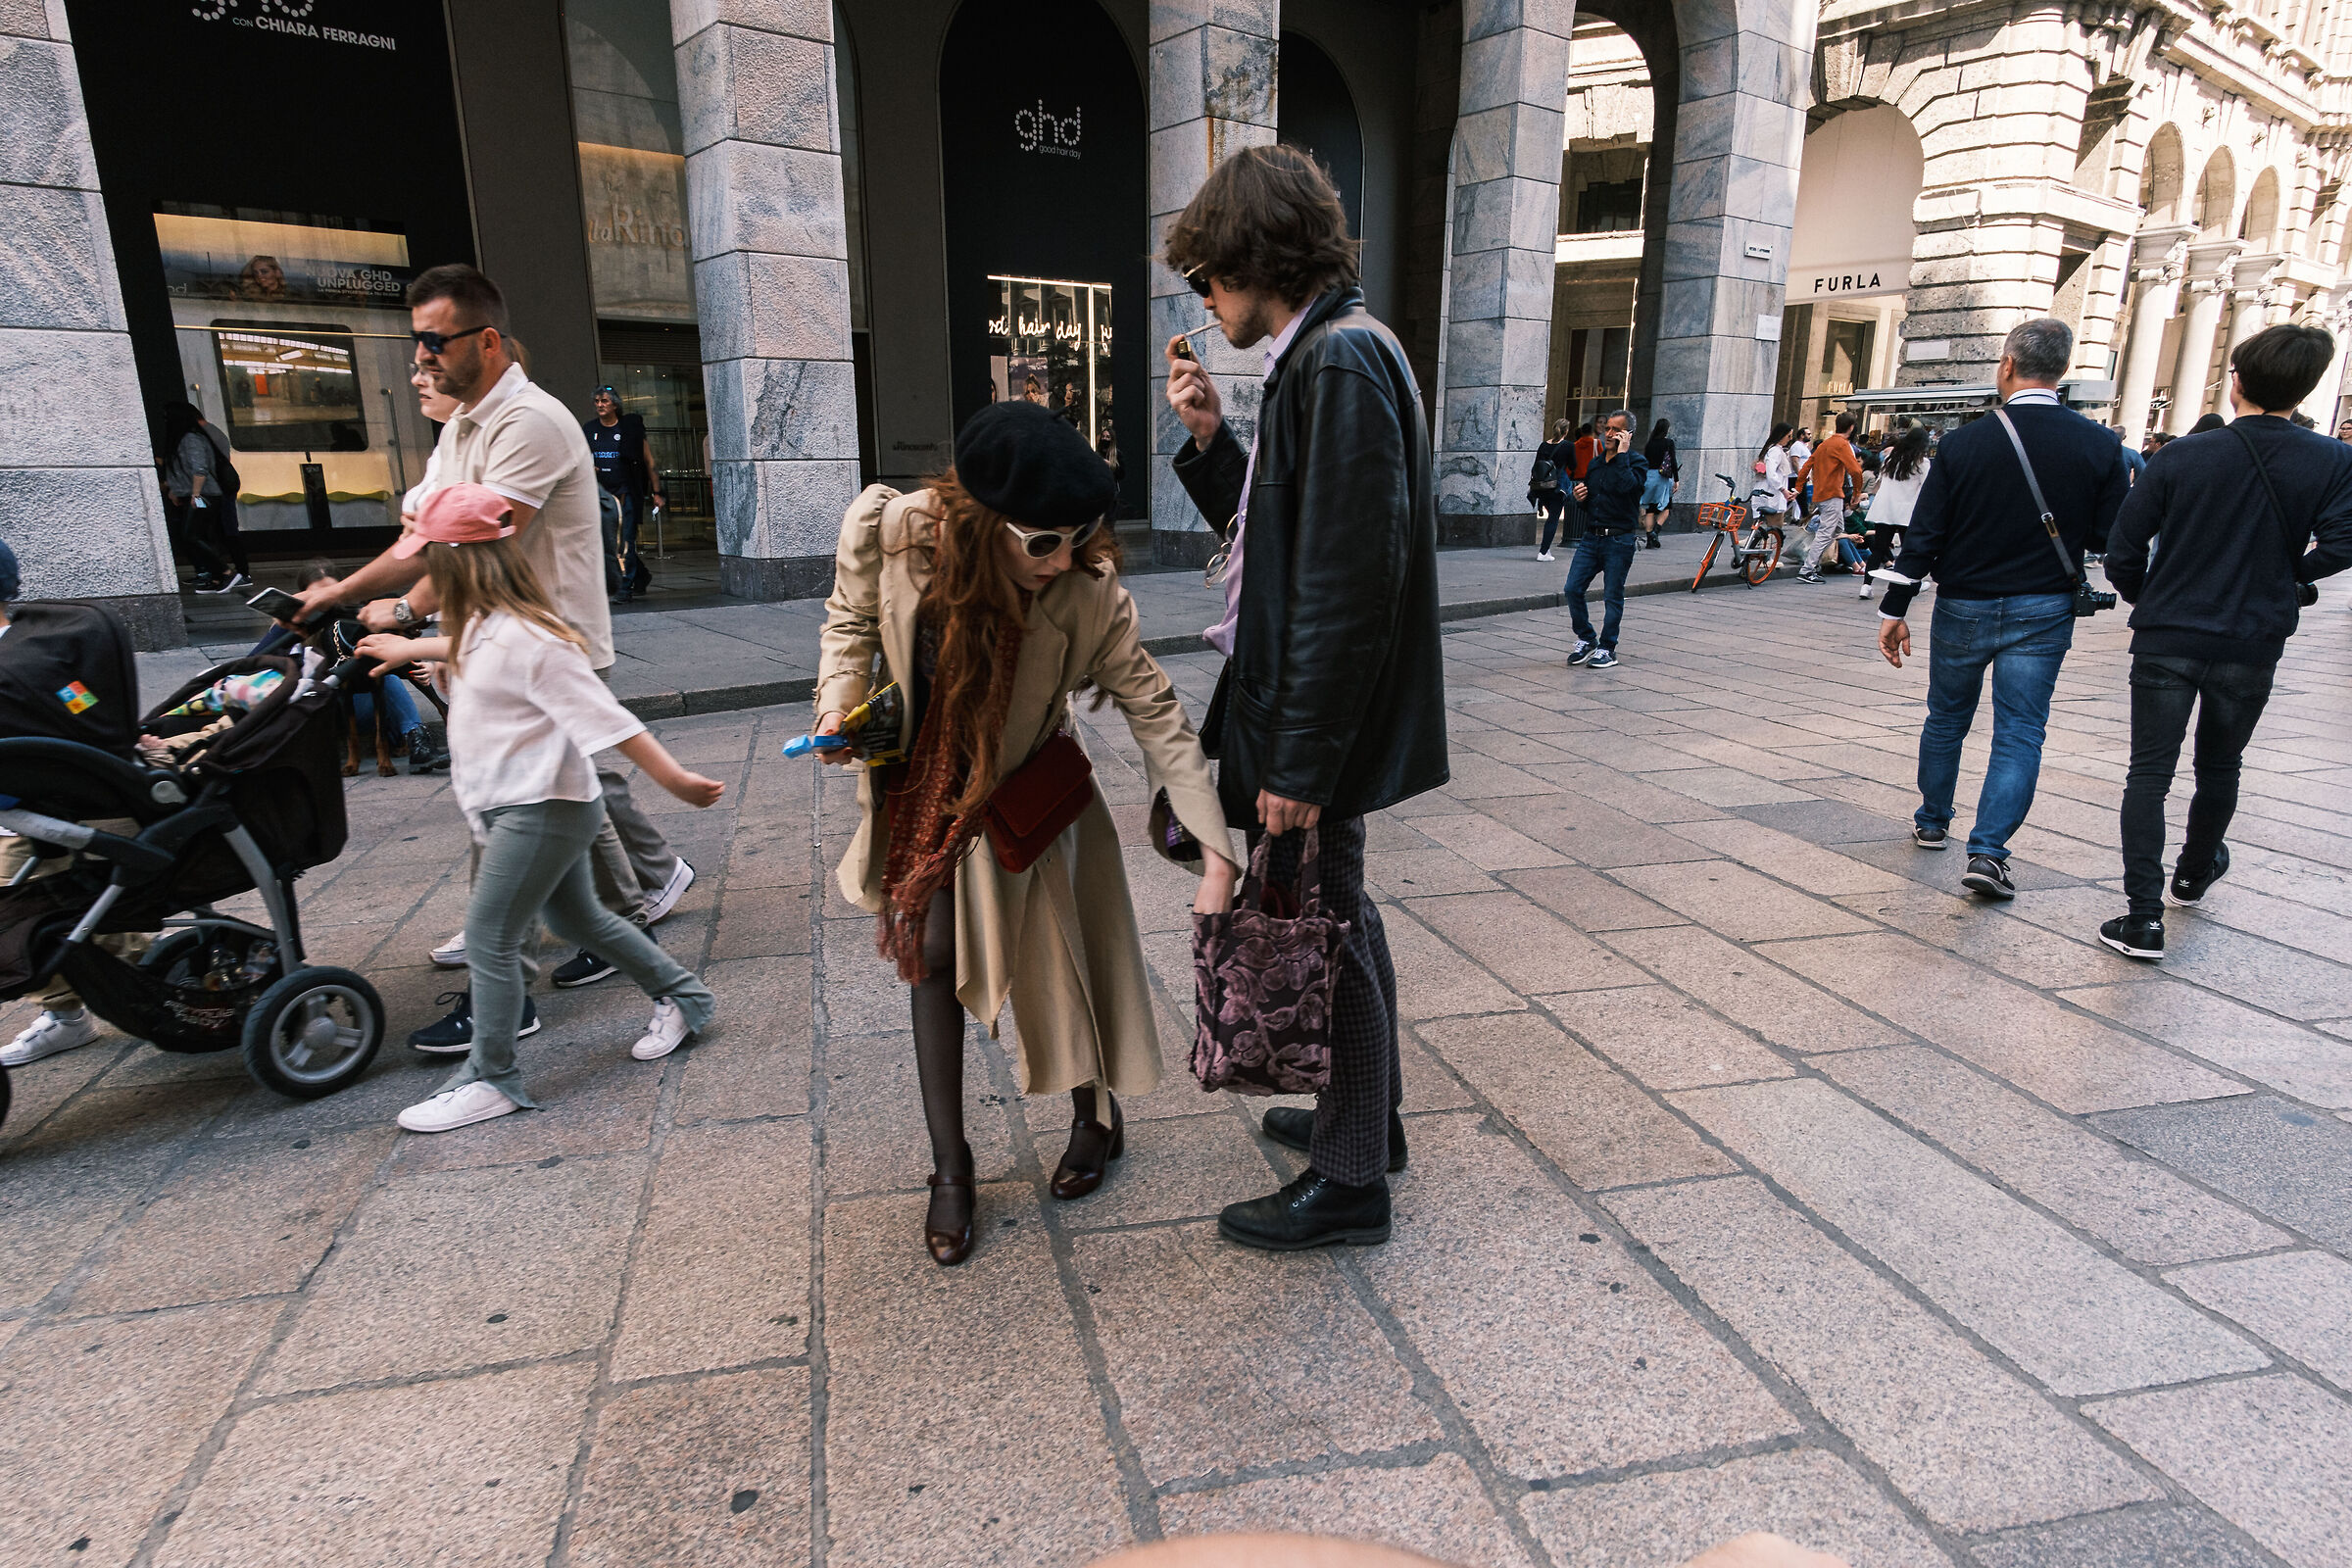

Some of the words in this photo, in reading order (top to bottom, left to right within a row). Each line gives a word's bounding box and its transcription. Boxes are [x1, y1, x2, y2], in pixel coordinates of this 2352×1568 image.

[232, 17, 254, 27] CON
[255, 16, 319, 38] CHIARA
[322, 26, 396, 50] FERRAGNI
[1014, 99, 1081, 152] ghd
[306, 264, 357, 279] NUOVA
[360, 269, 392, 281] GHD
[317, 276, 401, 292] UNPLUGGED
[1814, 272, 1881, 293] FURLA
[1018, 316, 1051, 336] hair
[1055, 319, 1082, 352] day
